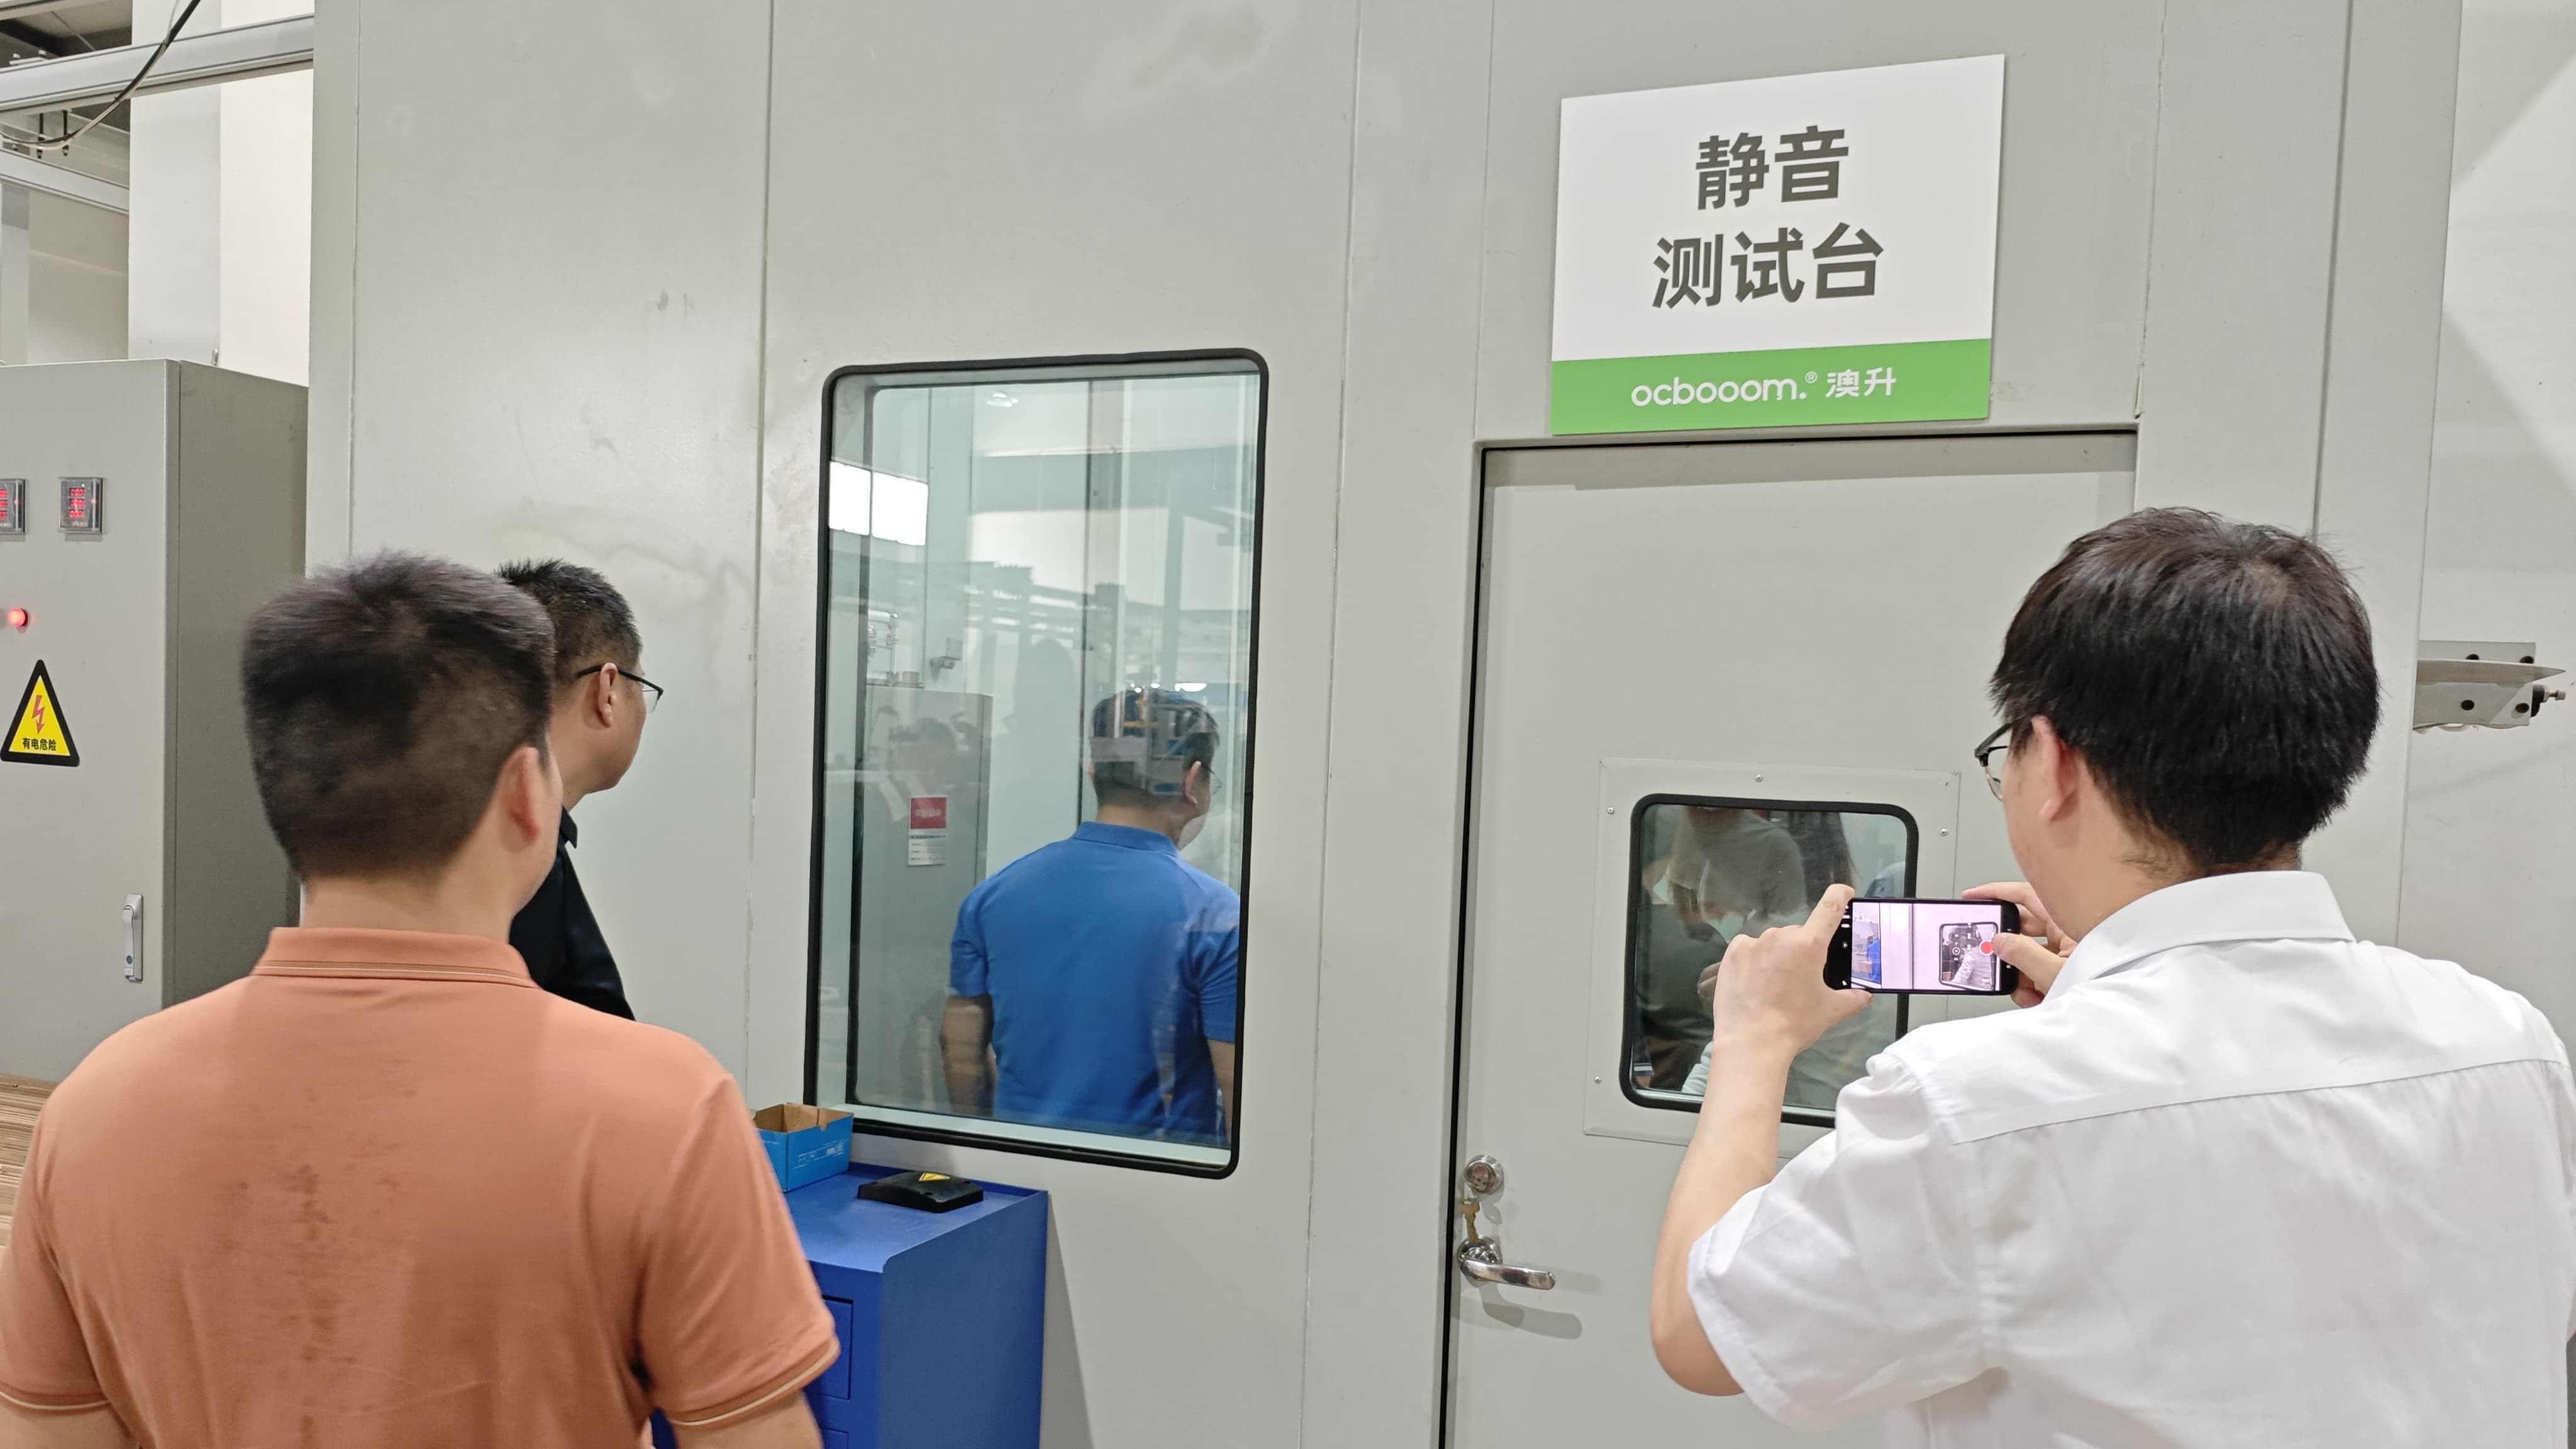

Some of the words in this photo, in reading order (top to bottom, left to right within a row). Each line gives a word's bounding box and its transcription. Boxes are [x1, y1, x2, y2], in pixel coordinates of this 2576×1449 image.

[1696, 125, 1849, 210] 静音
[1652, 222, 1884, 309] 测试台
[1825, 367, 1896, 398] 澳升
[23, 737, 57, 751] 有电危险
